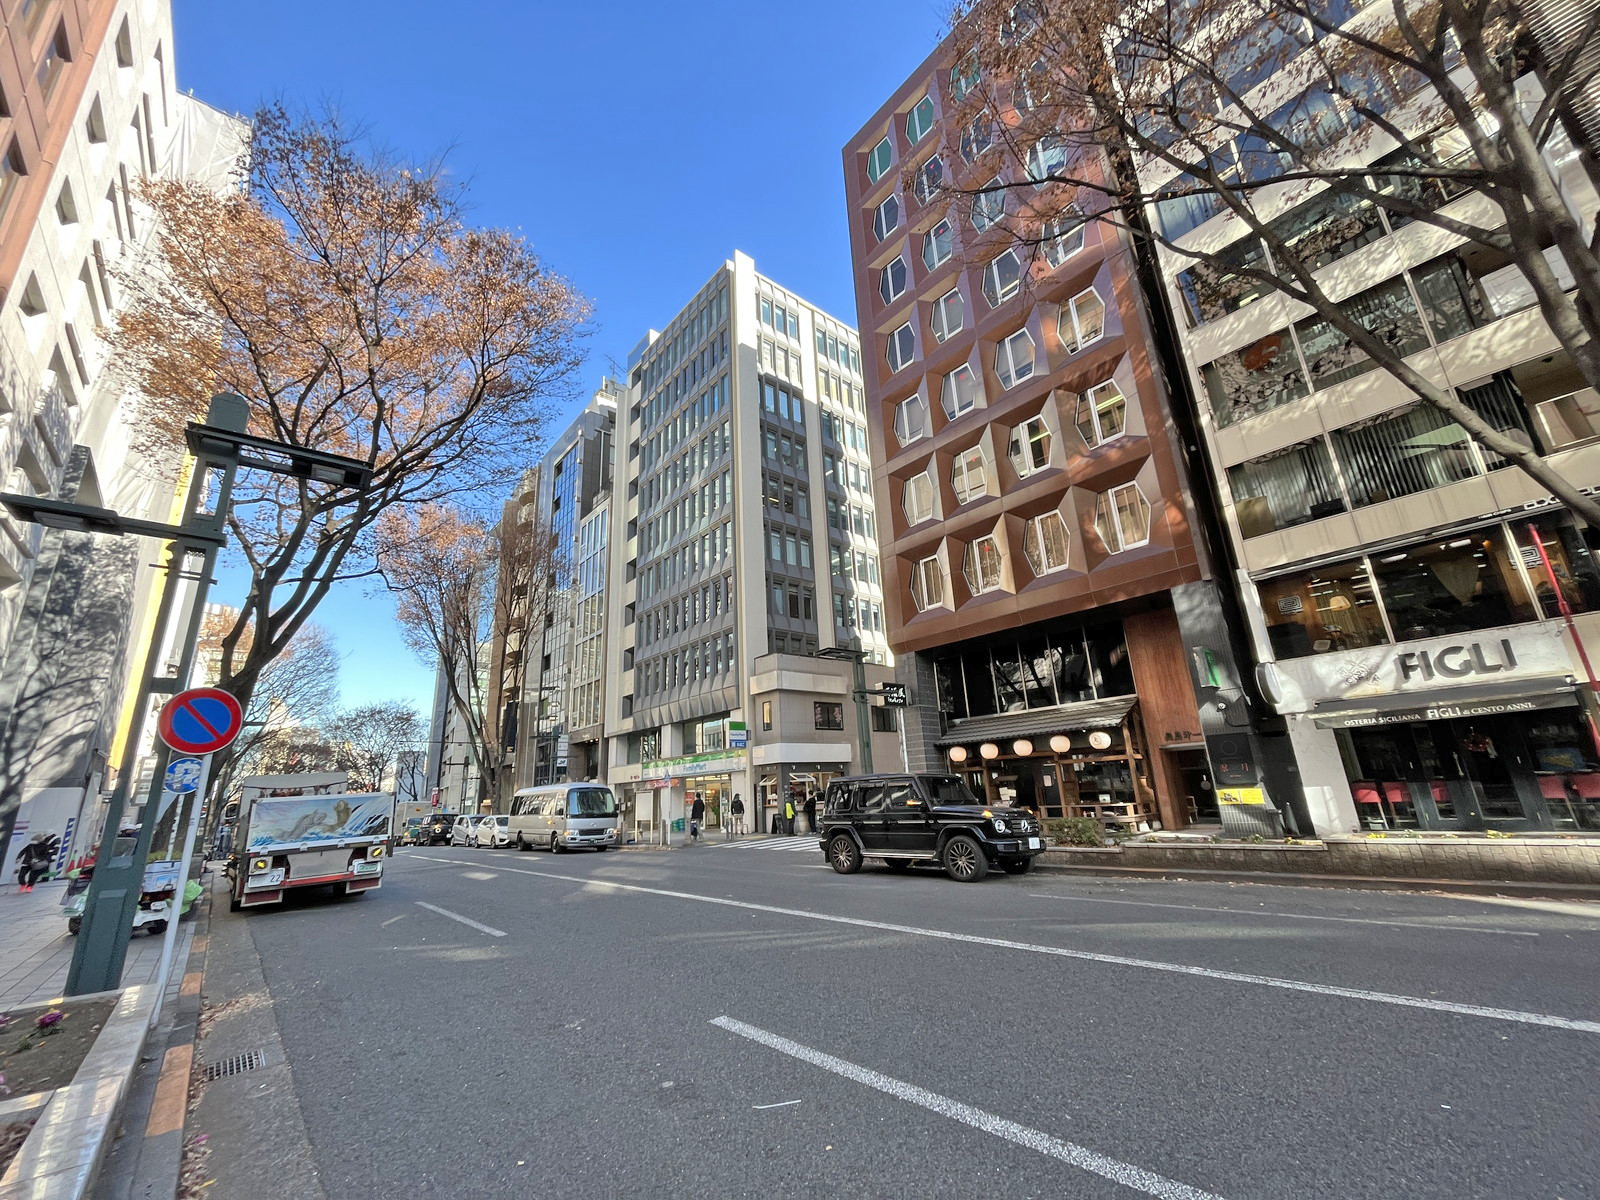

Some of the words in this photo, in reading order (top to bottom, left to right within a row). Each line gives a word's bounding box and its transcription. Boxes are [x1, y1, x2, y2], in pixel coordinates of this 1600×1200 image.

[1394, 639, 1517, 681] FIGLI
[1344, 717, 1378, 726] OSTERIA
[1378, 713, 1421, 724] SICILIANA
[1427, 706, 1461, 719] FIGLI
[1471, 704, 1505, 714] CENTO
